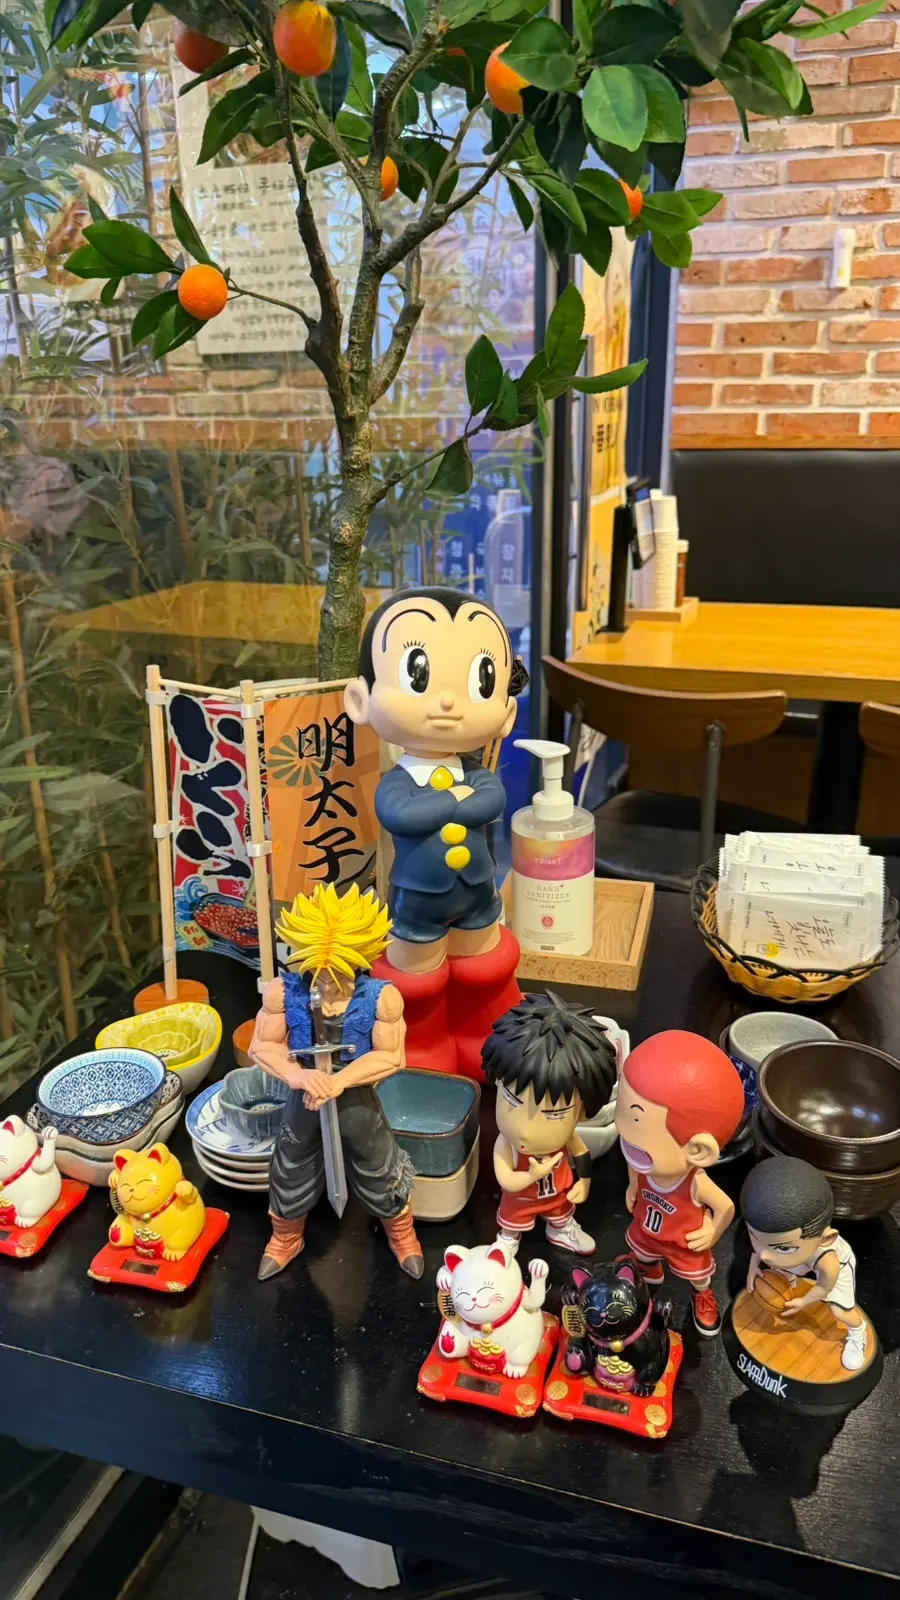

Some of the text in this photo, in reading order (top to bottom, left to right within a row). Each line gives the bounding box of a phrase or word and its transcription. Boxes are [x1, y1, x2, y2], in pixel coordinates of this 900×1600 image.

[296, 710, 366, 884] 明太子
[526, 889, 571, 900] SANITIZER
[764, 909, 788, 950] 너에게
[537, 1172, 557, 1198] 11
[642, 1189, 676, 1214] SHOHOKU
[644, 1205, 663, 1234] 10
